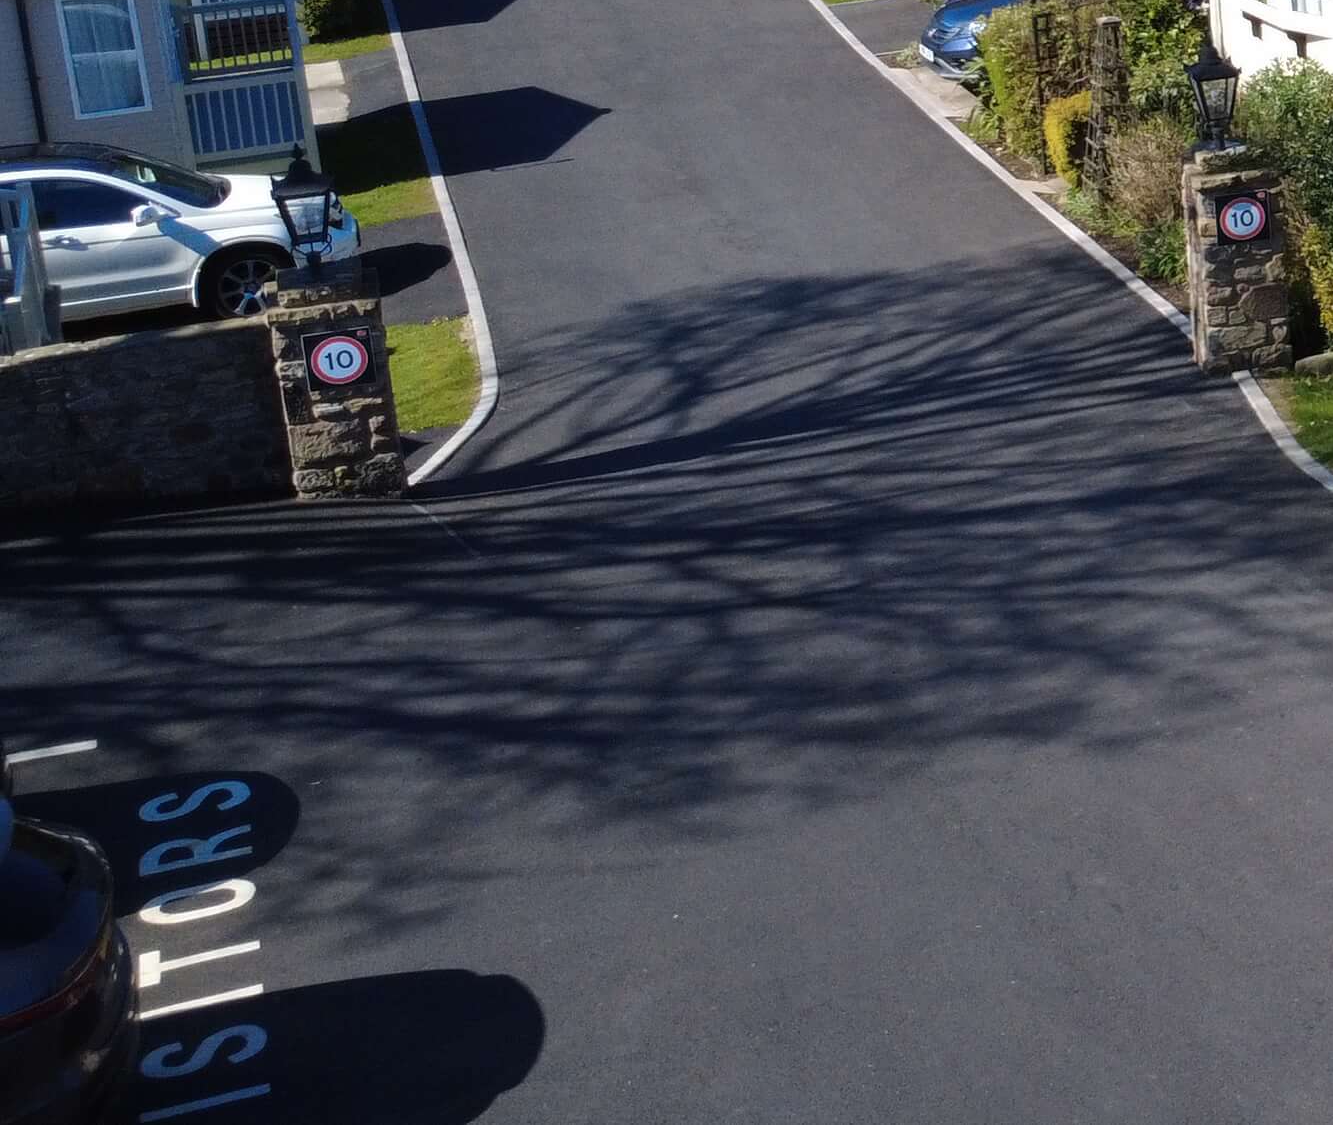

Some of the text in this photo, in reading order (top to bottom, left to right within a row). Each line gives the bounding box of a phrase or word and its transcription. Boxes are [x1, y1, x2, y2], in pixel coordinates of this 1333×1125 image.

[1231, 209, 1254, 228] 10
[324, 349, 354, 370] 10
[138, 779, 271, 1124] ISITORS
